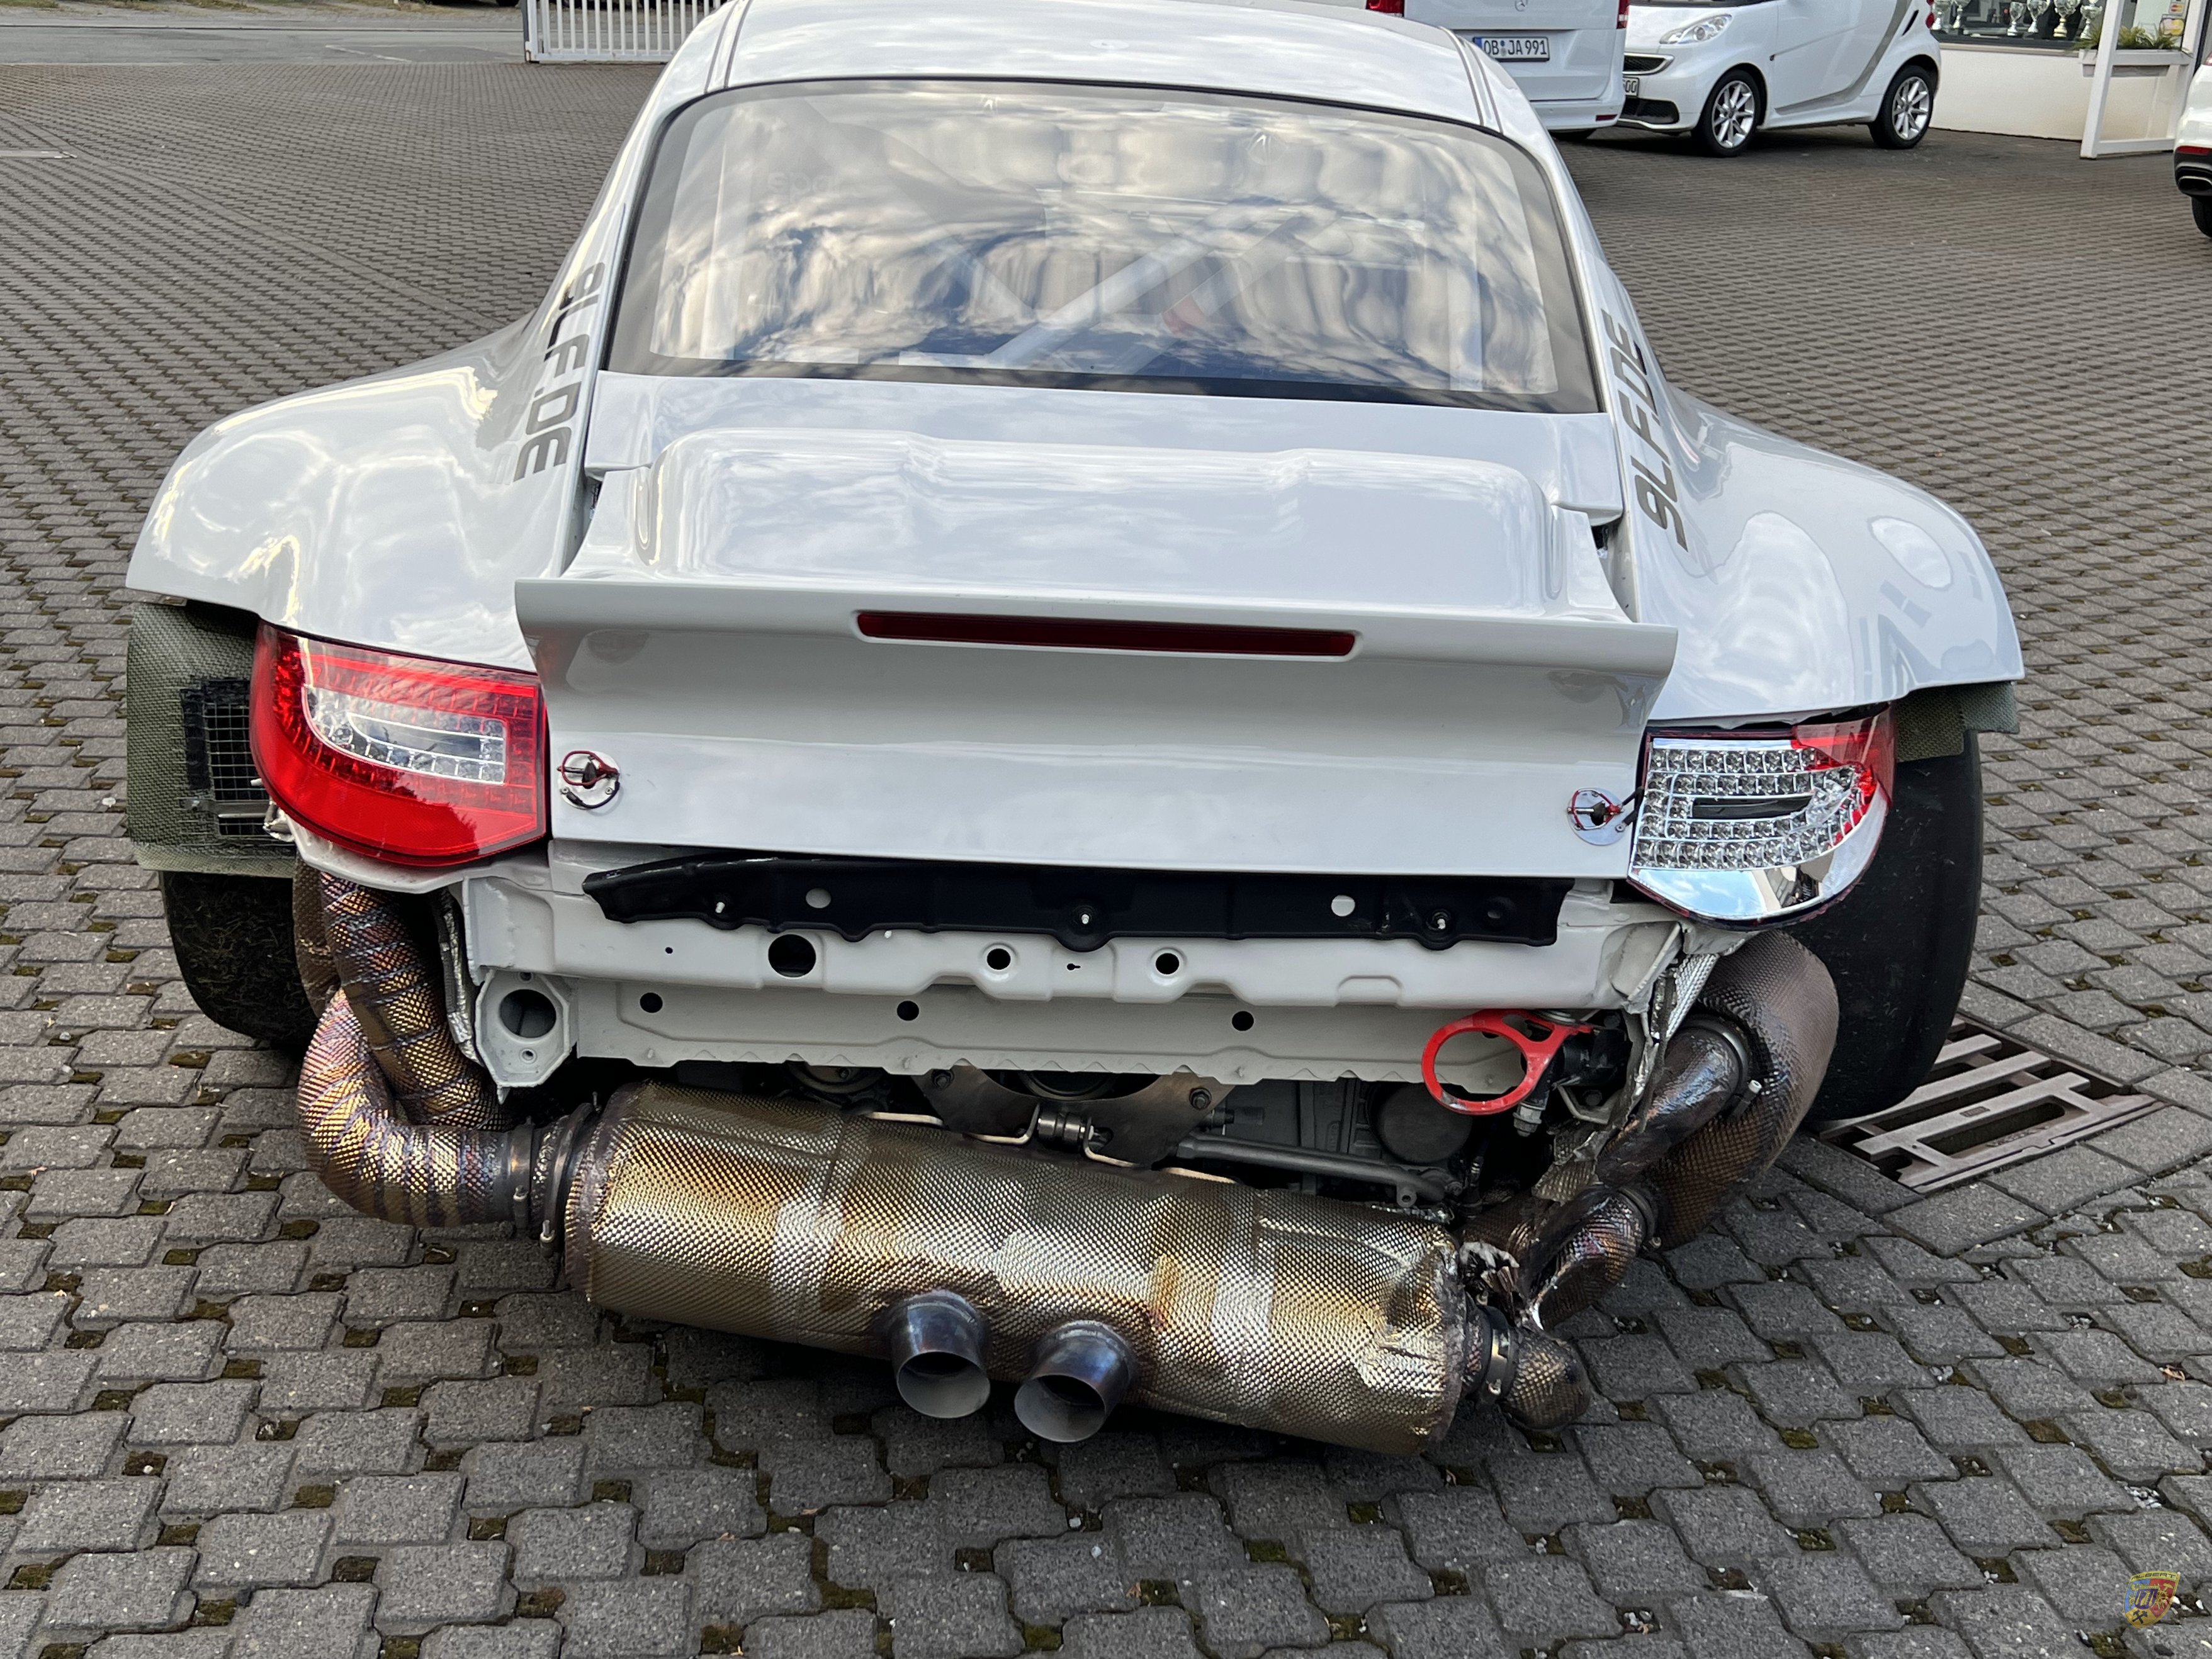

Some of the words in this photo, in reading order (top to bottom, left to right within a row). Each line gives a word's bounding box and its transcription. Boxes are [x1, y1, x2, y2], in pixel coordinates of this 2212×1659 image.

[1484, 40, 1499, 55] OB
[1508, 40, 1523, 55] JA
[1525, 40, 1547, 55] 991
